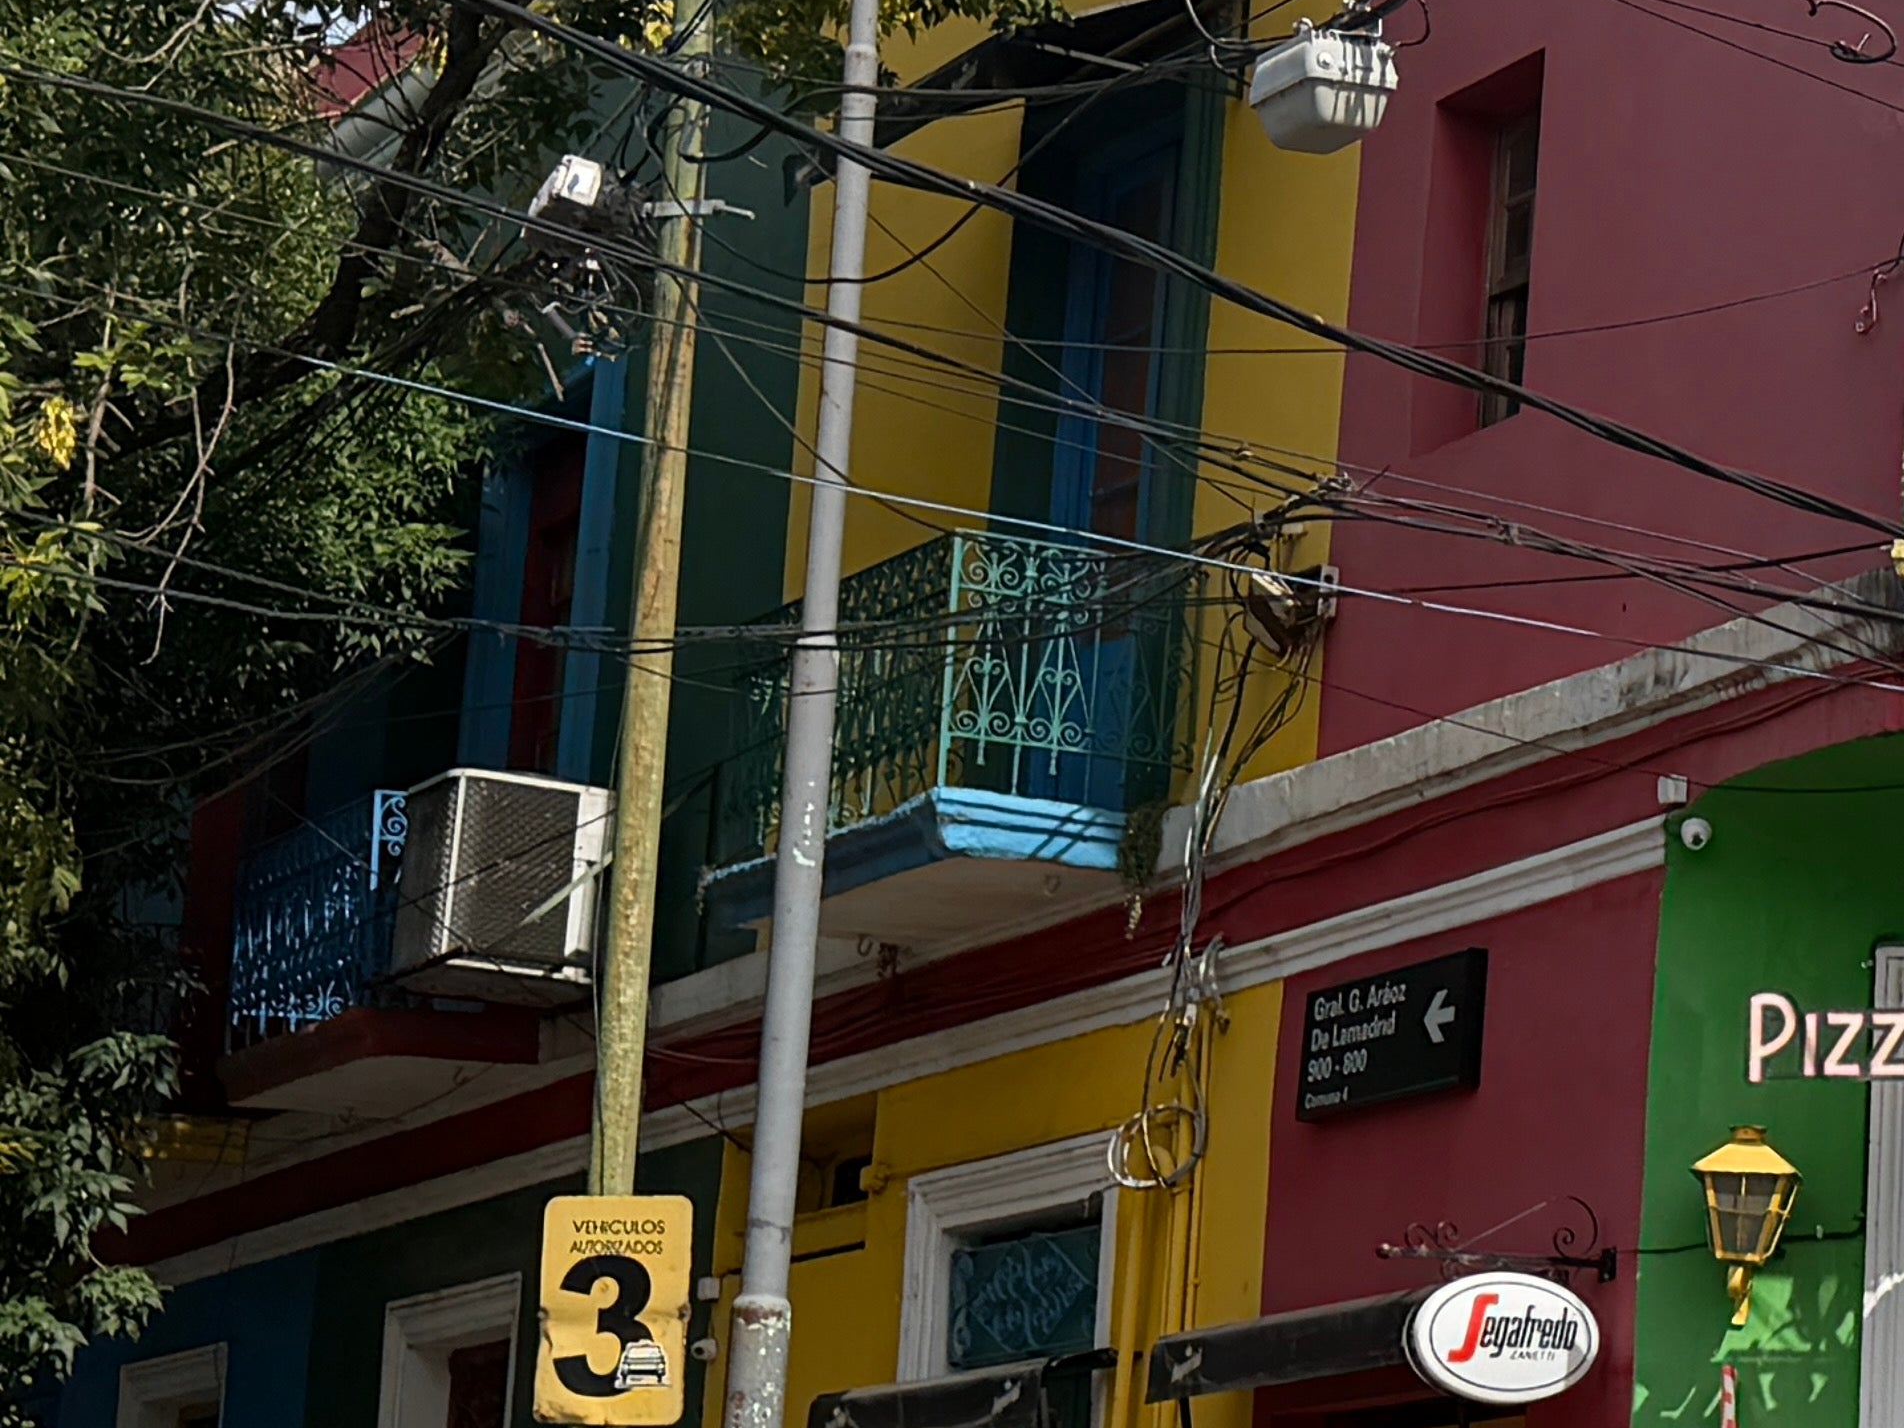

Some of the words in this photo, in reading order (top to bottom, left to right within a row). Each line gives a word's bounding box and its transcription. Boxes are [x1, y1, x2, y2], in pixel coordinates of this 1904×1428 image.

[1348, 988, 1364, 1013] G.
[1310, 1028, 1330, 1052] De
[552, 1254, 652, 1397] 3
[1447, 1292, 1579, 1363] Segafredo
